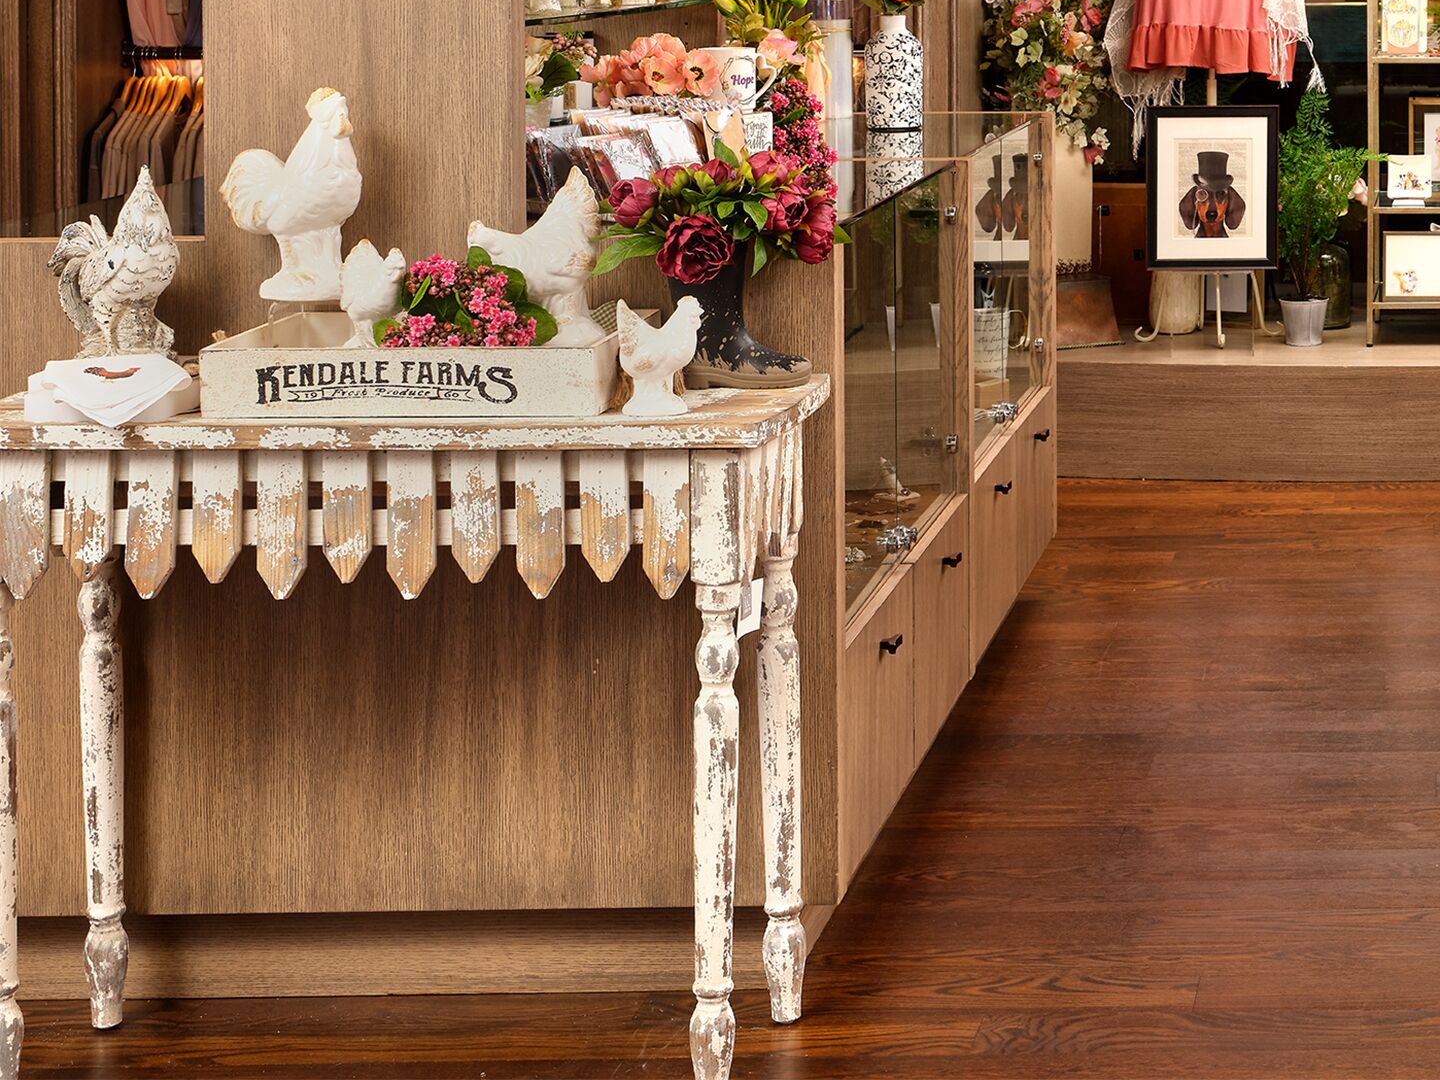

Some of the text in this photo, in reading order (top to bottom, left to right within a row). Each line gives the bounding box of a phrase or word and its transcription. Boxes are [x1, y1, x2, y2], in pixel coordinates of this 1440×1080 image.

[731, 74, 754, 89] Hope
[256, 360, 518, 404] KENDALE FARMS
[331, 388, 368, 397] Fresh
[375, 387, 431, 397] Produce
